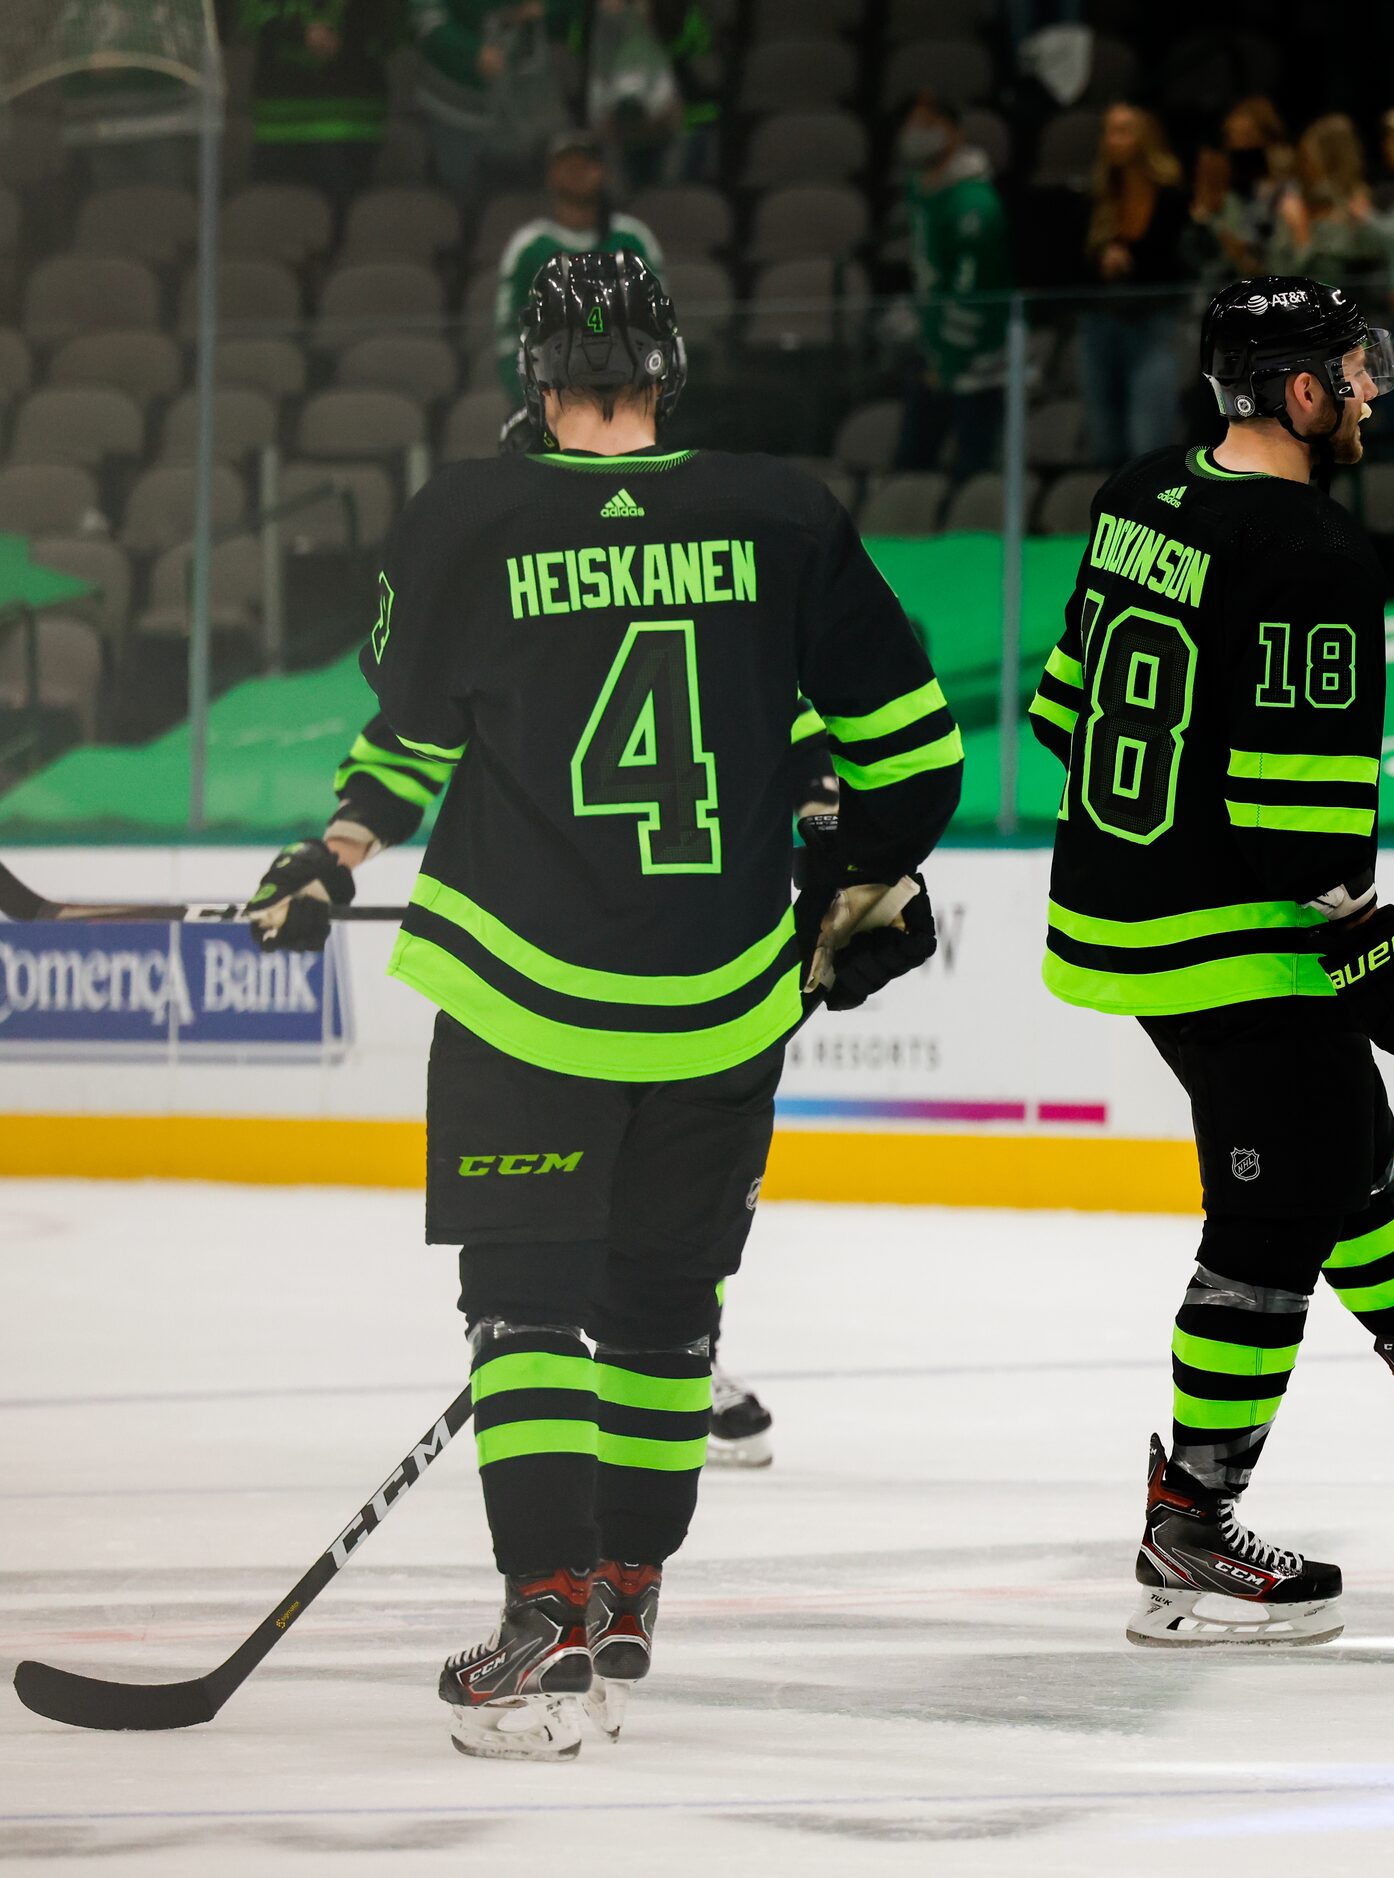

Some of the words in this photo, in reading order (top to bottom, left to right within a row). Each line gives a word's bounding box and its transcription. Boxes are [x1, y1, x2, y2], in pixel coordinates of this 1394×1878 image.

[1272, 290, 1308, 307] AT&T
[587, 306, 604, 333] 4
[600, 505, 646, 517] adidas
[1156, 491, 1182, 509] adidas
[506, 539, 757, 620] HEISKANEN
[1255, 621, 1356, 709] 18
[570, 619, 723, 875] 4
[203, 938, 318, 1014] Bank
[457, 1151, 585, 1178] CCM
[325, 1416, 452, 1571] CCM
[1213, 1558, 1266, 1587] CCM
[468, 1651, 507, 1683] CCM
